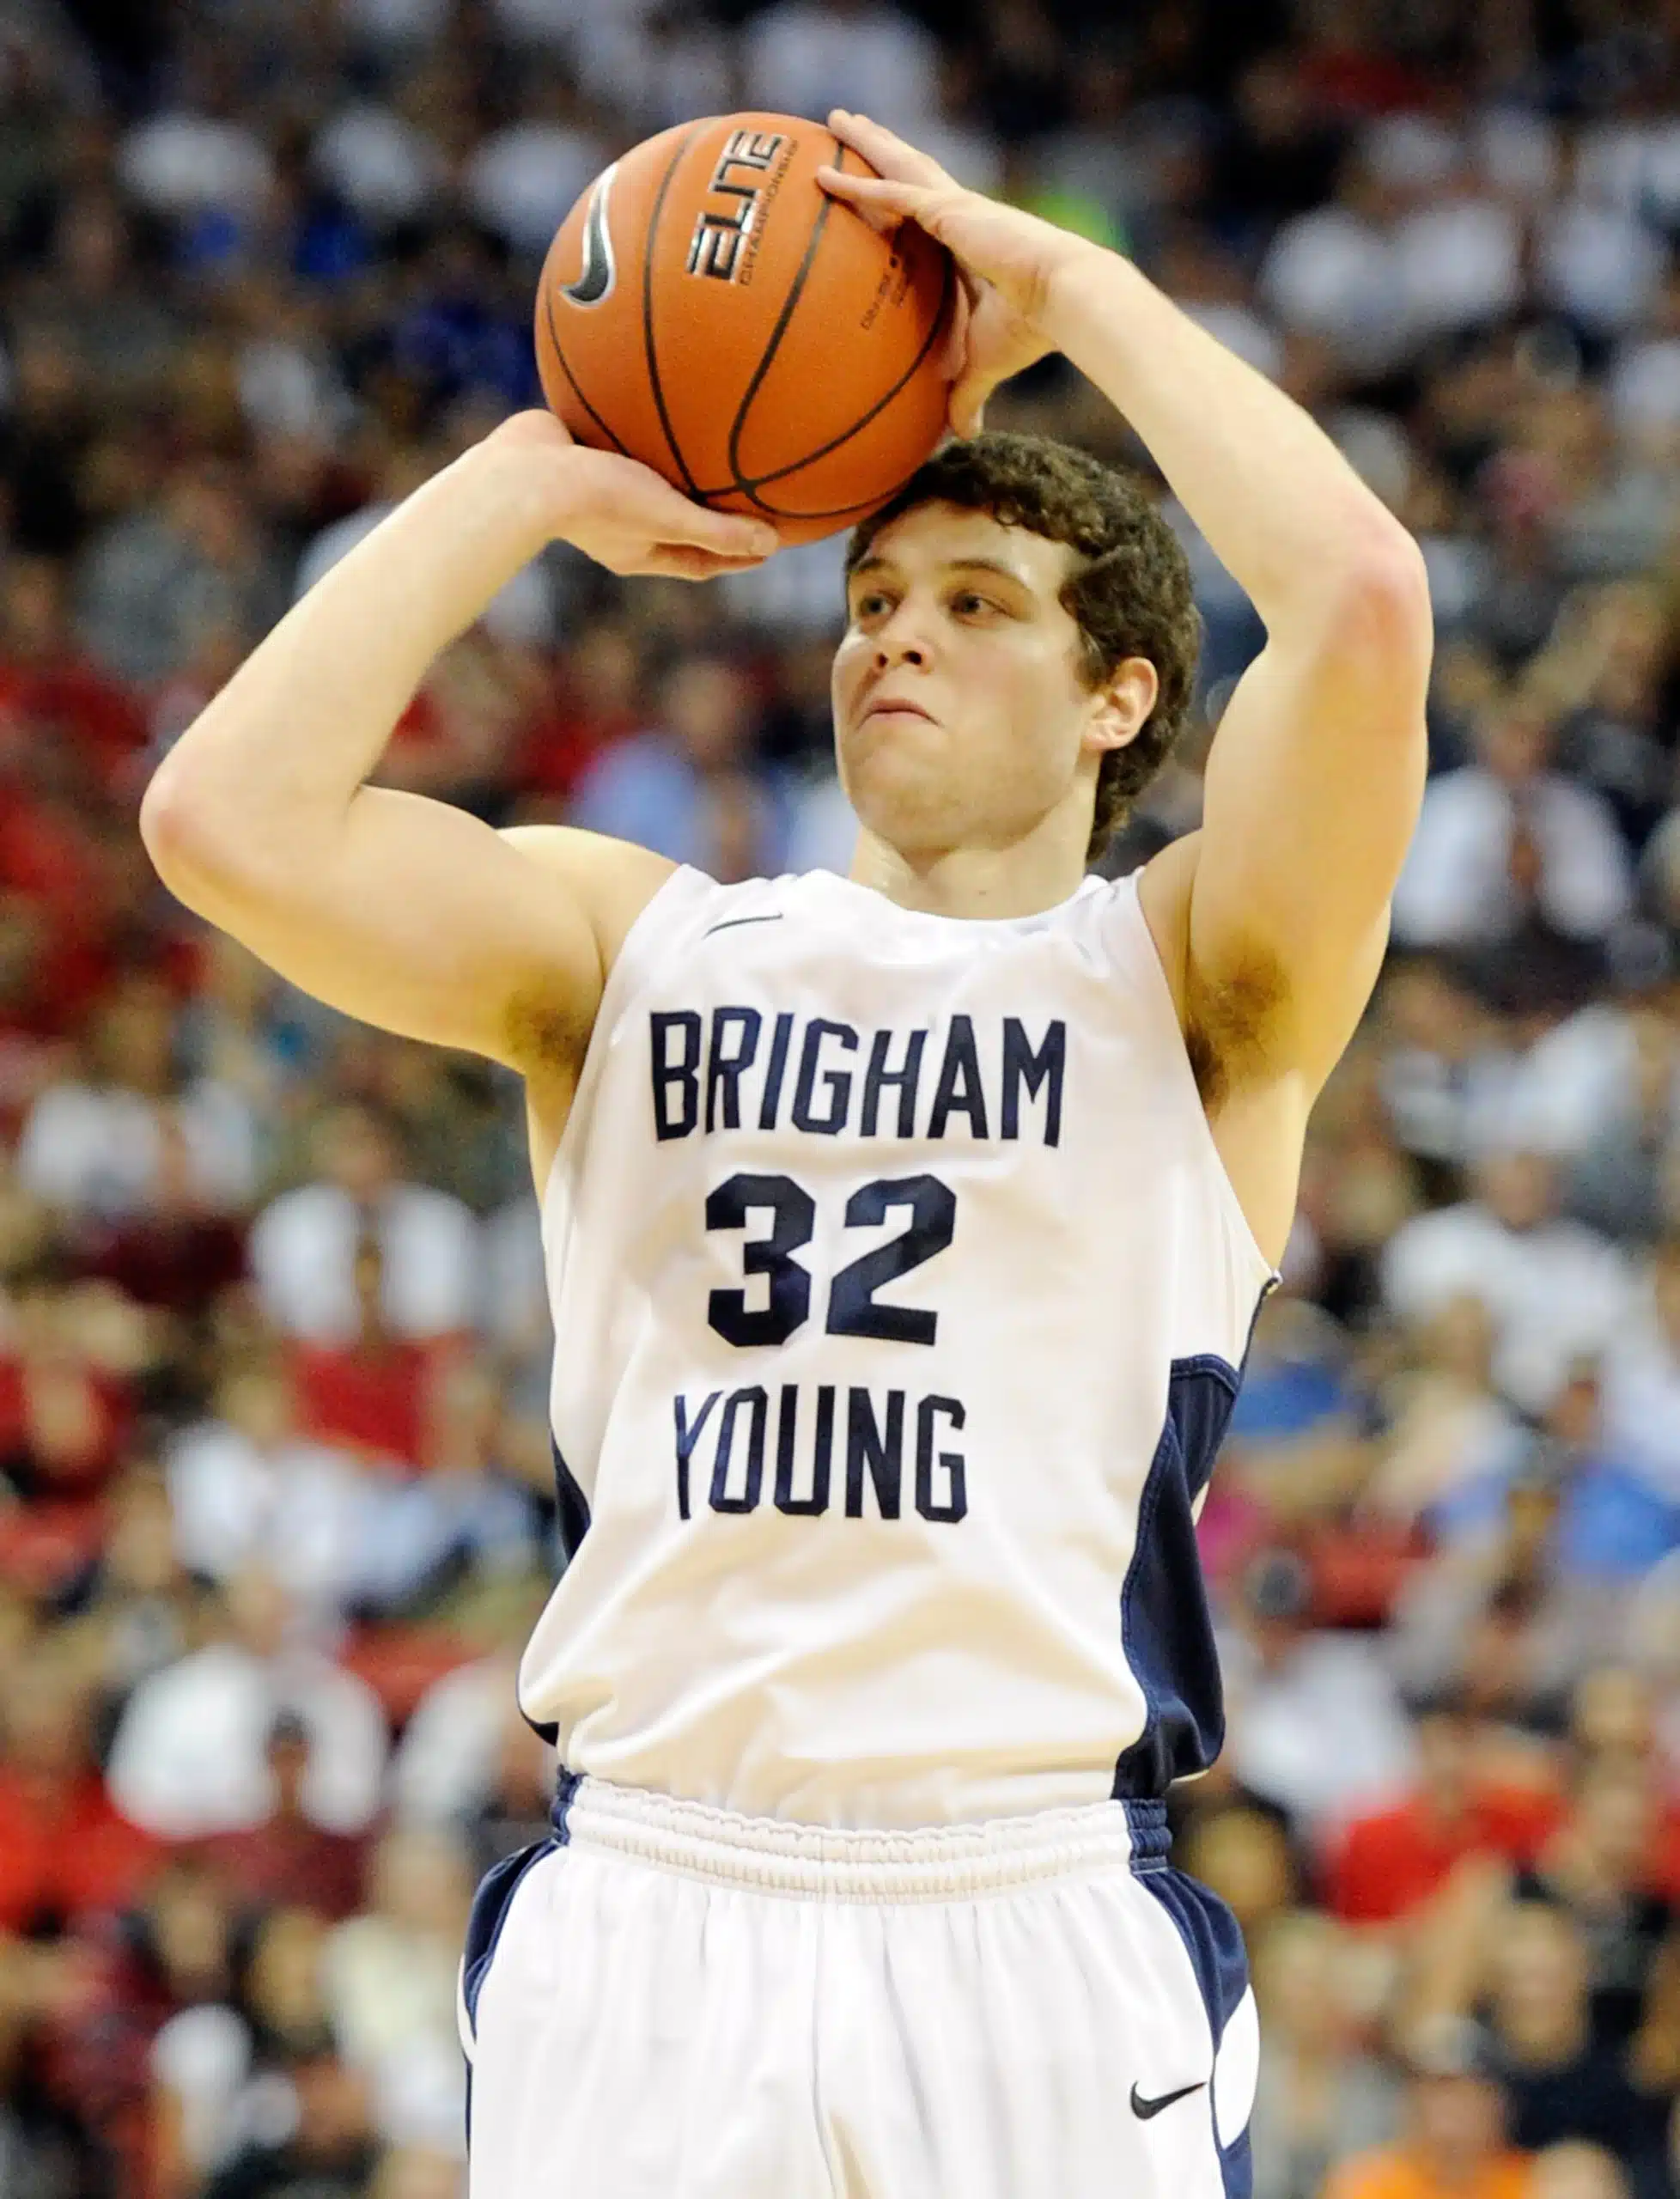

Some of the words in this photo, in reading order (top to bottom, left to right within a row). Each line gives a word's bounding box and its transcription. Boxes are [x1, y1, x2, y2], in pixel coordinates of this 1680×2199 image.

[686, 129, 785, 283] ELITE
[649, 1007, 1066, 1148] BRIGHAM
[705, 1173, 957, 1348] 32
[674, 1384, 967, 1524] YOUNG
